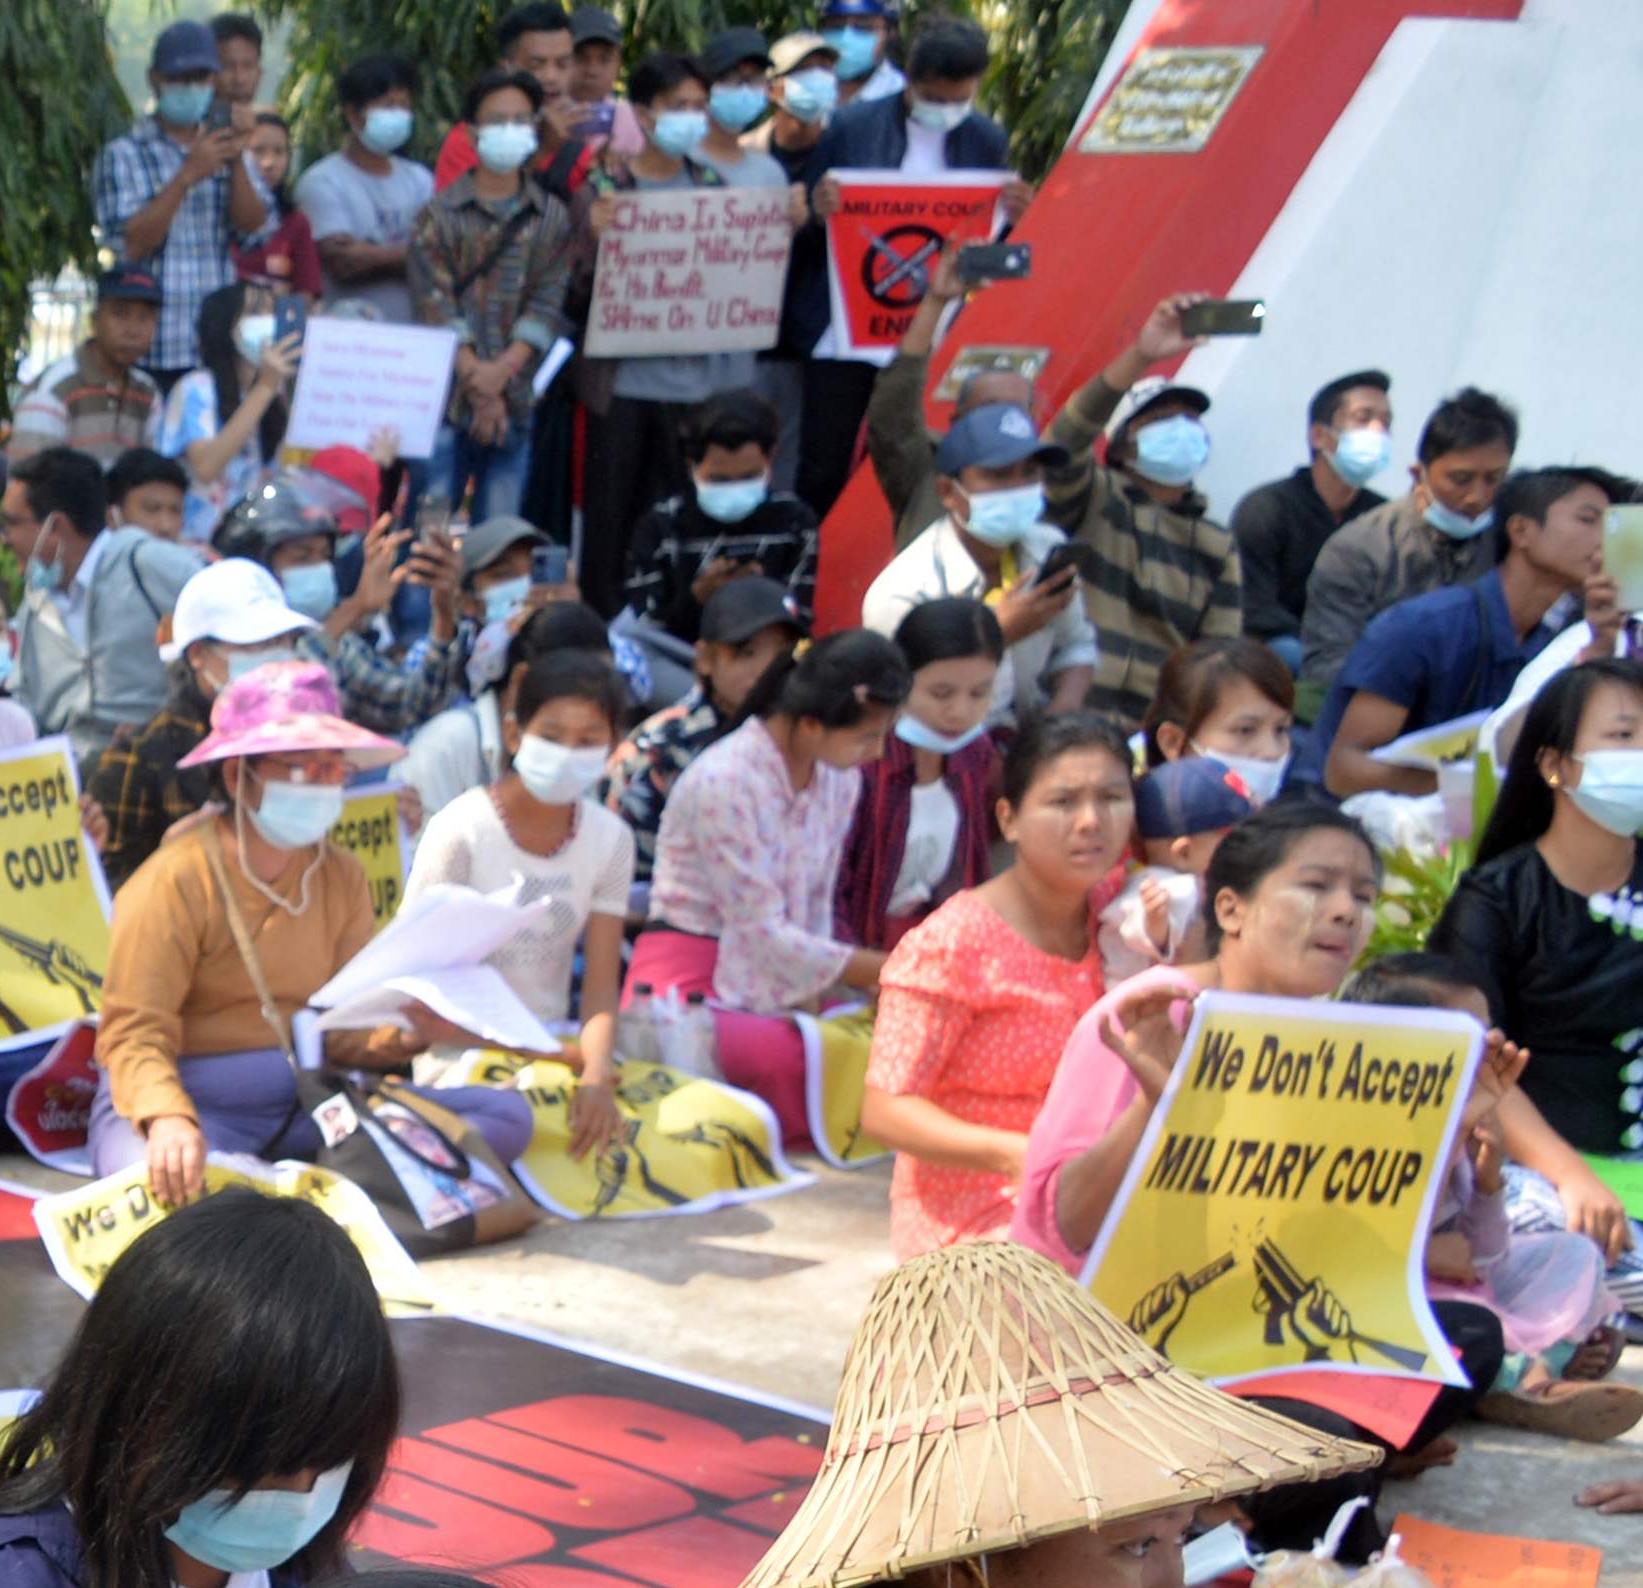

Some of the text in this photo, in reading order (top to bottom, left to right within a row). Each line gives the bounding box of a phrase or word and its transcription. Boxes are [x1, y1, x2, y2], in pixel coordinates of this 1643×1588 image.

[843, 202, 927, 215] MILITARY
[330, 806, 393, 857] ccept
[12, 838, 80, 894] COUP
[1192, 1029, 1455, 1120] We Don't Accept
[1145, 1133, 1424, 1207] MILITARY COUP
[65, 1202, 118, 1243] We
